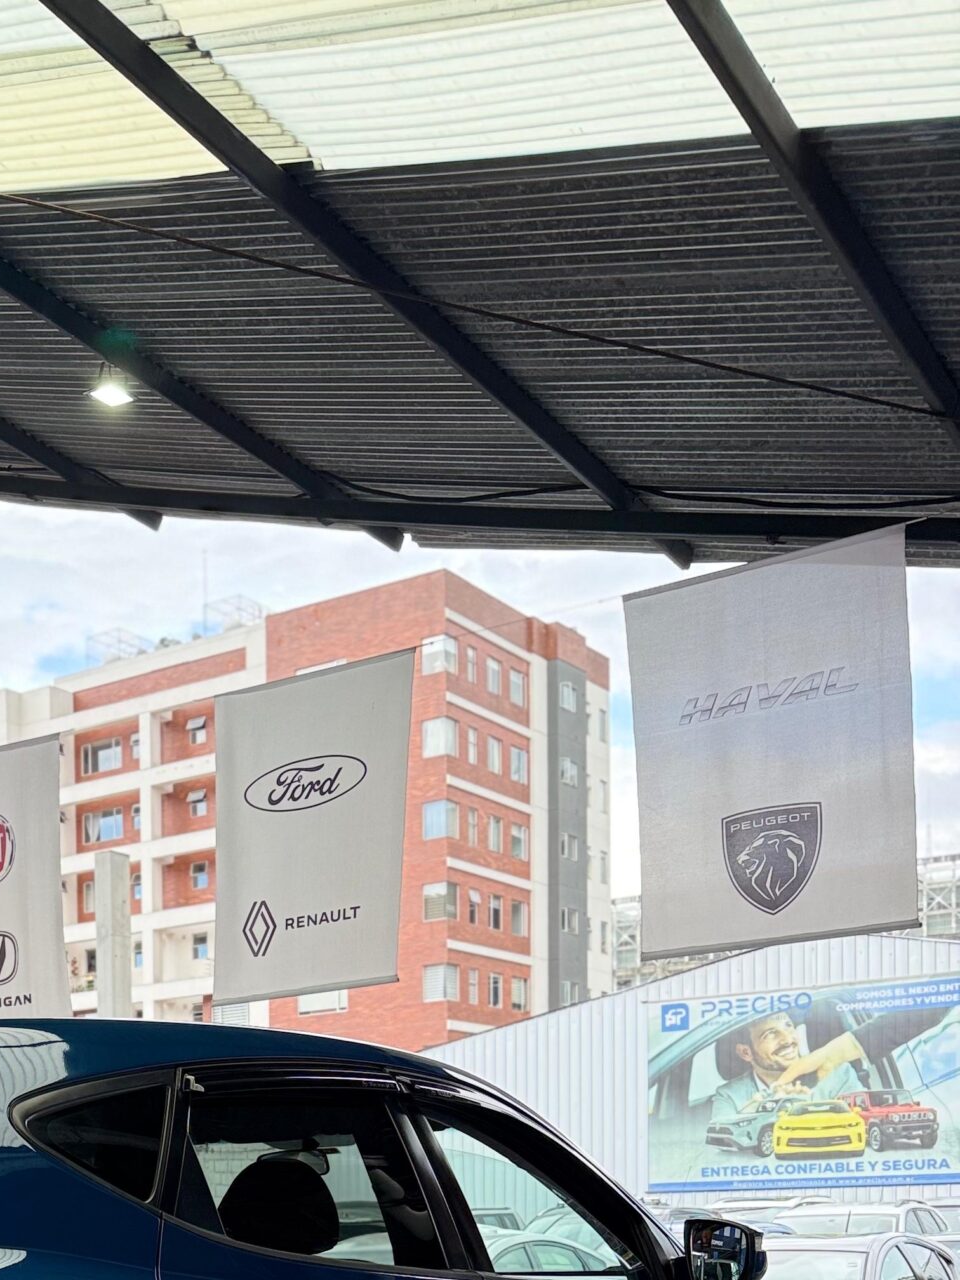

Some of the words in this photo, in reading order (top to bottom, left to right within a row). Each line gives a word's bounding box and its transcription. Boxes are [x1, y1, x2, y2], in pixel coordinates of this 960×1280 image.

[679, 666, 859, 726] HAVAL
[267, 762, 343, 806] Ford
[730, 812, 812, 834] PEUGEOT
[285, 905, 361, 931] RENAULT
[836, 997, 914, 1012] COMPRADORES
[855, 990, 893, 1000] SOMOS
[895, 988, 907, 996] EL
[909, 985, 938, 994] NEXO
[700, 992, 813, 1019] PRECISO
[701, 1165, 772, 1178] ENTREGA
[774, 1161, 865, 1175] CONFIABLE
[868, 1161, 879, 1172] Y
[881, 1158, 951, 1171] SEGURA
